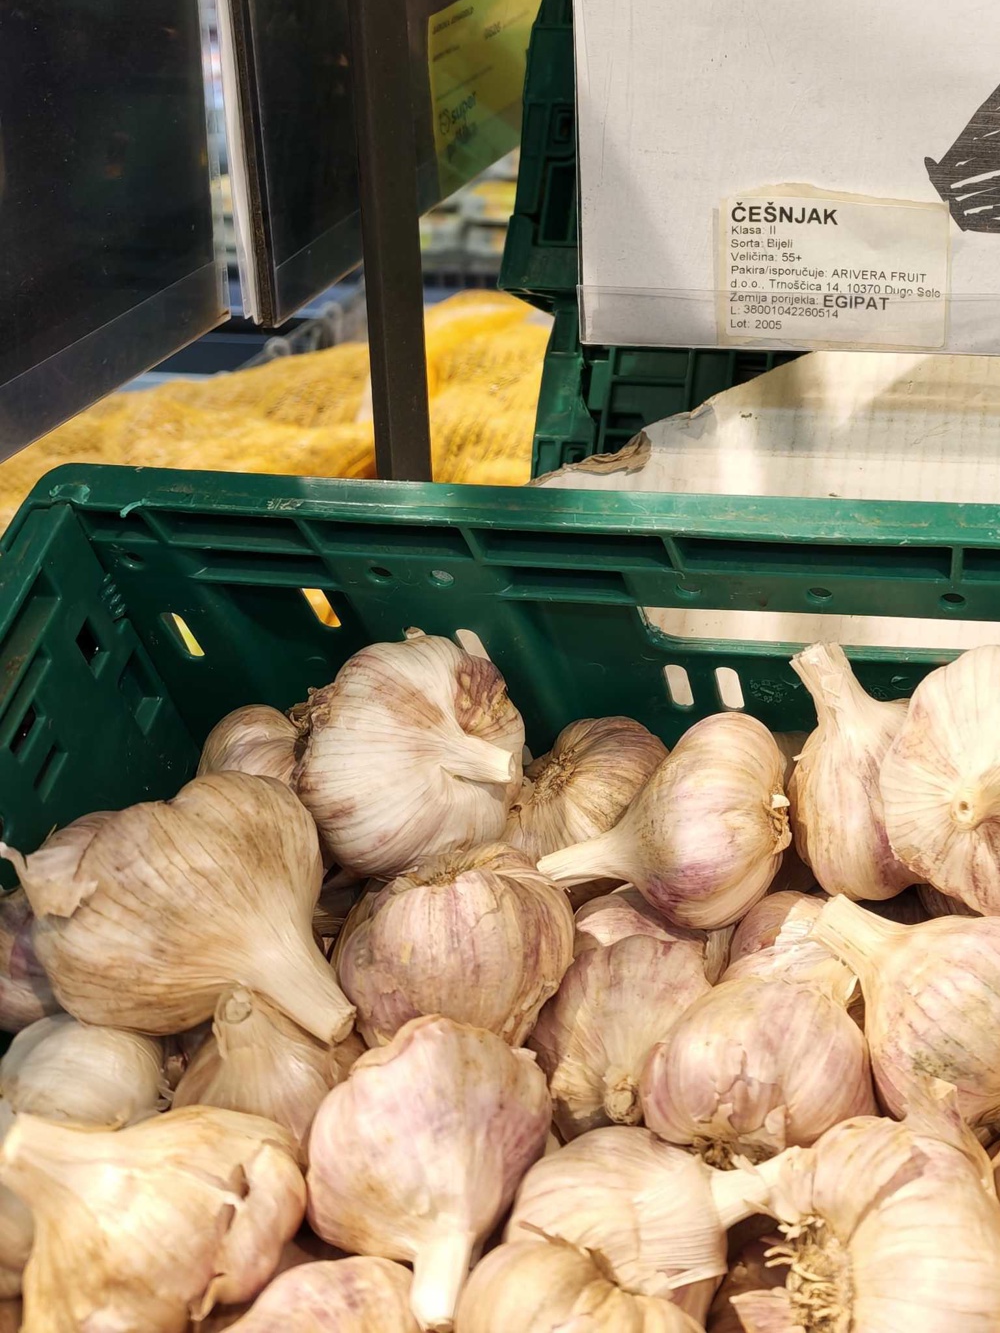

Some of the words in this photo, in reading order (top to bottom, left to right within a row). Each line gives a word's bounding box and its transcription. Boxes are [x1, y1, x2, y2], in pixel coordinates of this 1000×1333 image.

[731, 202, 838, 225] ČEŠNJAK
[731, 226, 765, 234] Klasa:
[769, 226, 776, 235] II
[731, 239, 764, 248] Sorta:
[767, 238, 793, 250] Bijeli
[731, 252, 777, 262] Veličina:
[781, 252, 802, 262] 55+
[731, 265, 828, 279] Pakira/isporučuje:
[832, 269, 886, 280] ARIVERA
[891, 272, 926, 283] FRUIT
[769, 279, 822, 291] Trnoščica
[847, 284, 881, 294] 10370
[730, 293, 767, 304] Zemlja
[771, 295, 819, 305] porijekla:
[823, 294, 889, 310] EGIPAT
[730, 306, 740, 315] L:
[743, 305, 838, 318] 38001042260514
[731, 319, 750, 328] Lot:
[755, 319, 782, 329] 2005
